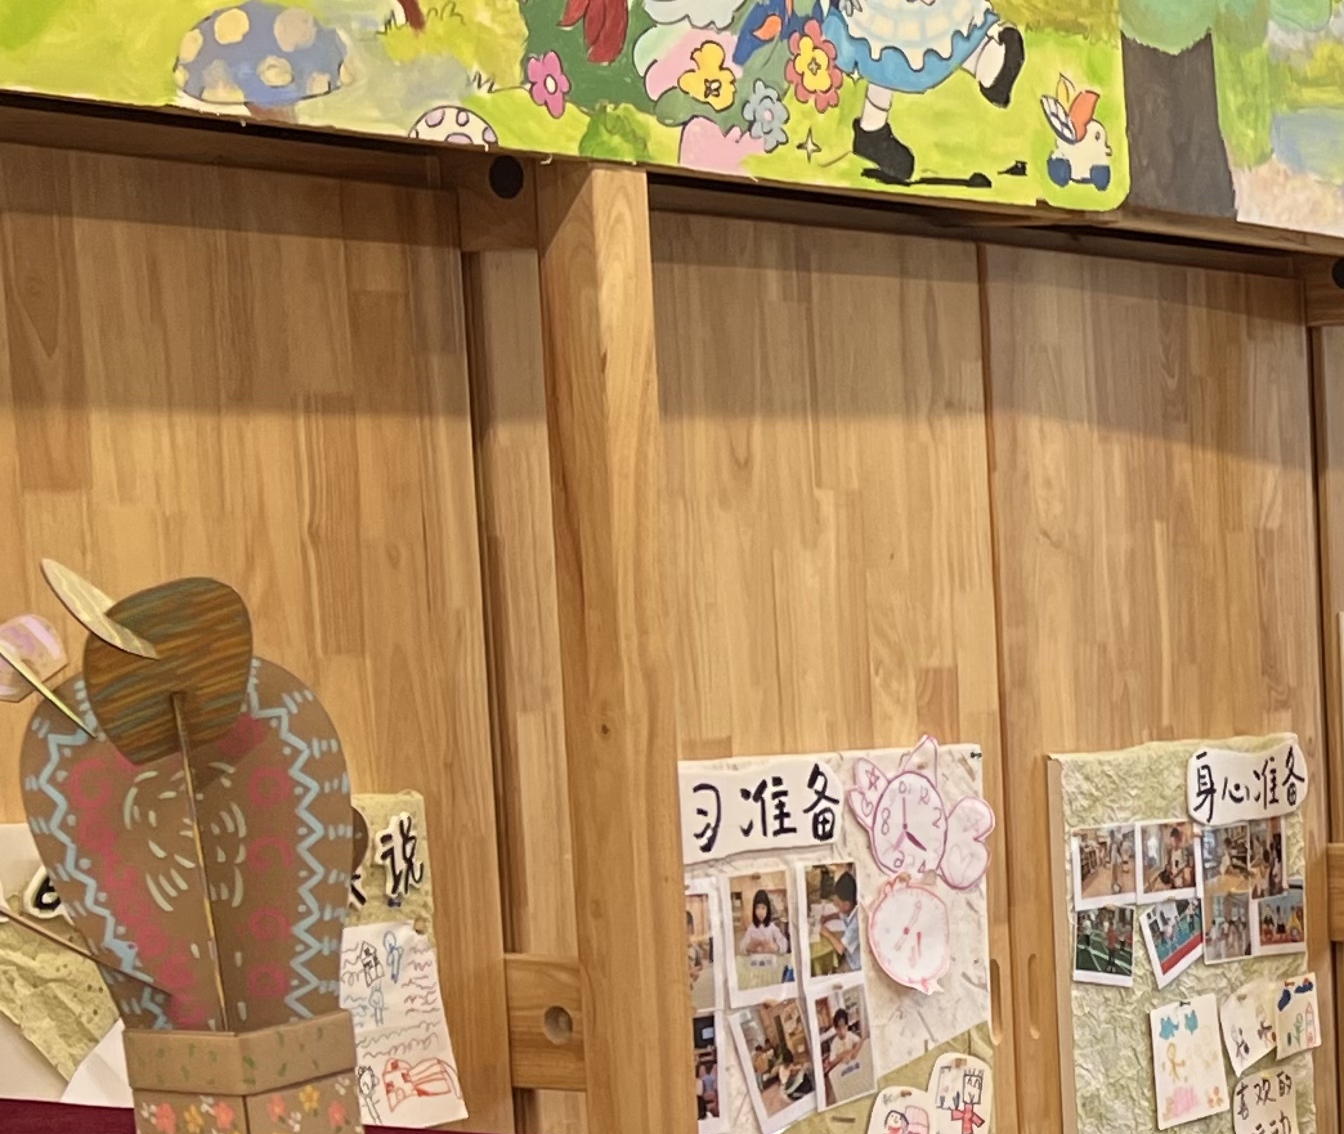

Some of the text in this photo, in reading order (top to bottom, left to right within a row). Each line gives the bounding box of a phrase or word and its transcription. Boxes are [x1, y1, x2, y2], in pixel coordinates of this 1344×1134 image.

[692, 763, 841, 852] 习准备
[1193, 746, 1305, 823] 身心准备
[1236, 1071, 1293, 1121] 喜欢的
